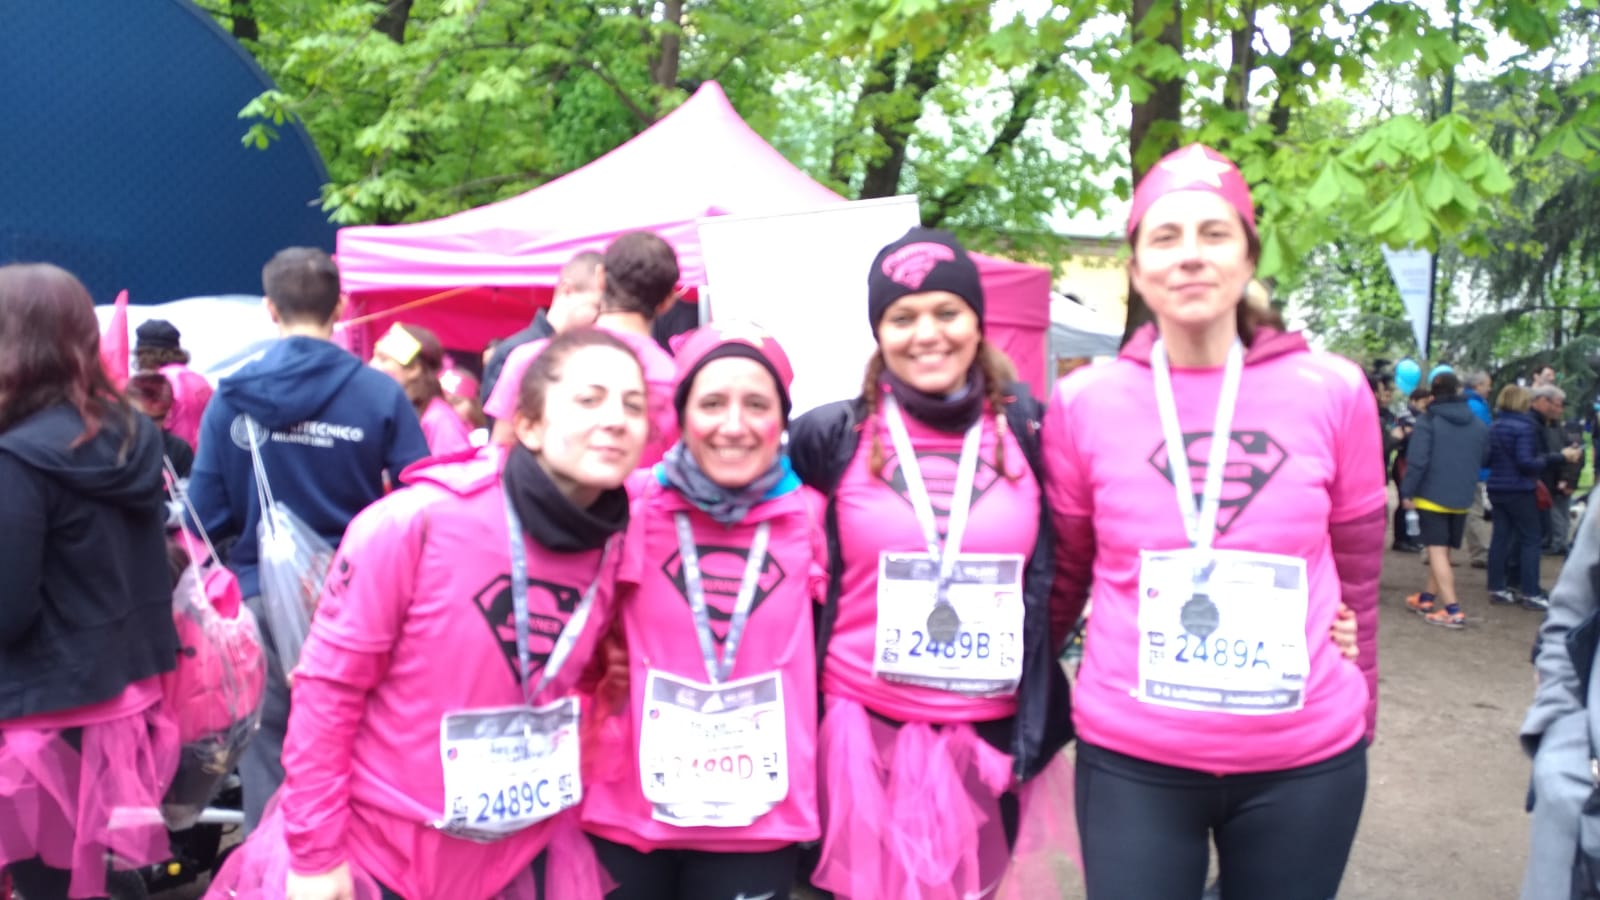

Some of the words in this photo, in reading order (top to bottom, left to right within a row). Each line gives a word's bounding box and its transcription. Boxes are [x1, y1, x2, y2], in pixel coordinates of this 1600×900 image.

[908, 630, 991, 659] 2489B
[1175, 633, 1271, 670] 2489A
[474, 778, 550, 824] 2489C
